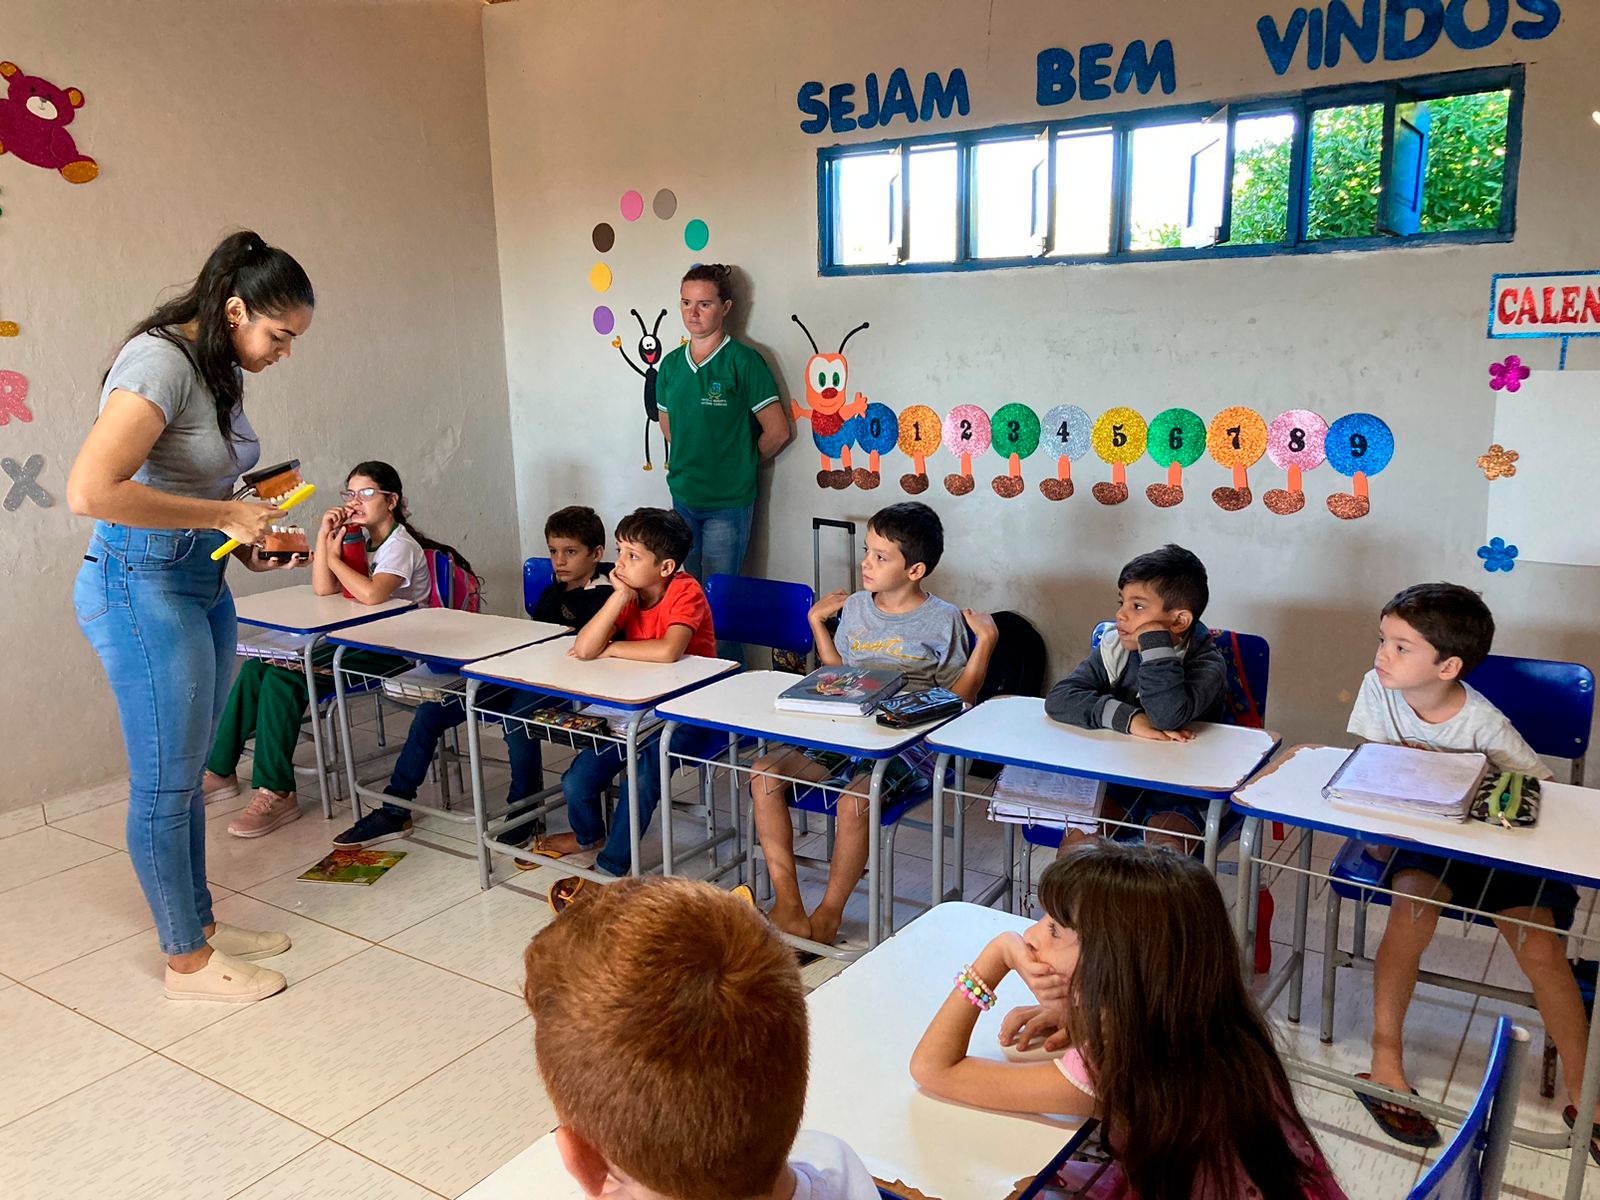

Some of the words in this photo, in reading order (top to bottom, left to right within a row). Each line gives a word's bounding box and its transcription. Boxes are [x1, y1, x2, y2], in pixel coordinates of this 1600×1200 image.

[797, 67, 970, 134] SEJAM
[1036, 39, 1176, 107] BEM
[1256, 0, 1561, 75] VINDOS
[1498, 286, 1600, 325] CALEN
[869, 417, 881, 439] 0
[913, 421, 923, 441] 1
[959, 419, 973, 441] 2
[1007, 420, 1020, 442] 3
[1056, 421, 1070, 443] 4
[1112, 424, 1128, 447] 5
[1168, 427, 1183, 450] 6
[1226, 425, 1241, 450] 7
[1288, 427, 1306, 453] 8
[1350, 433, 1368, 458] 9
